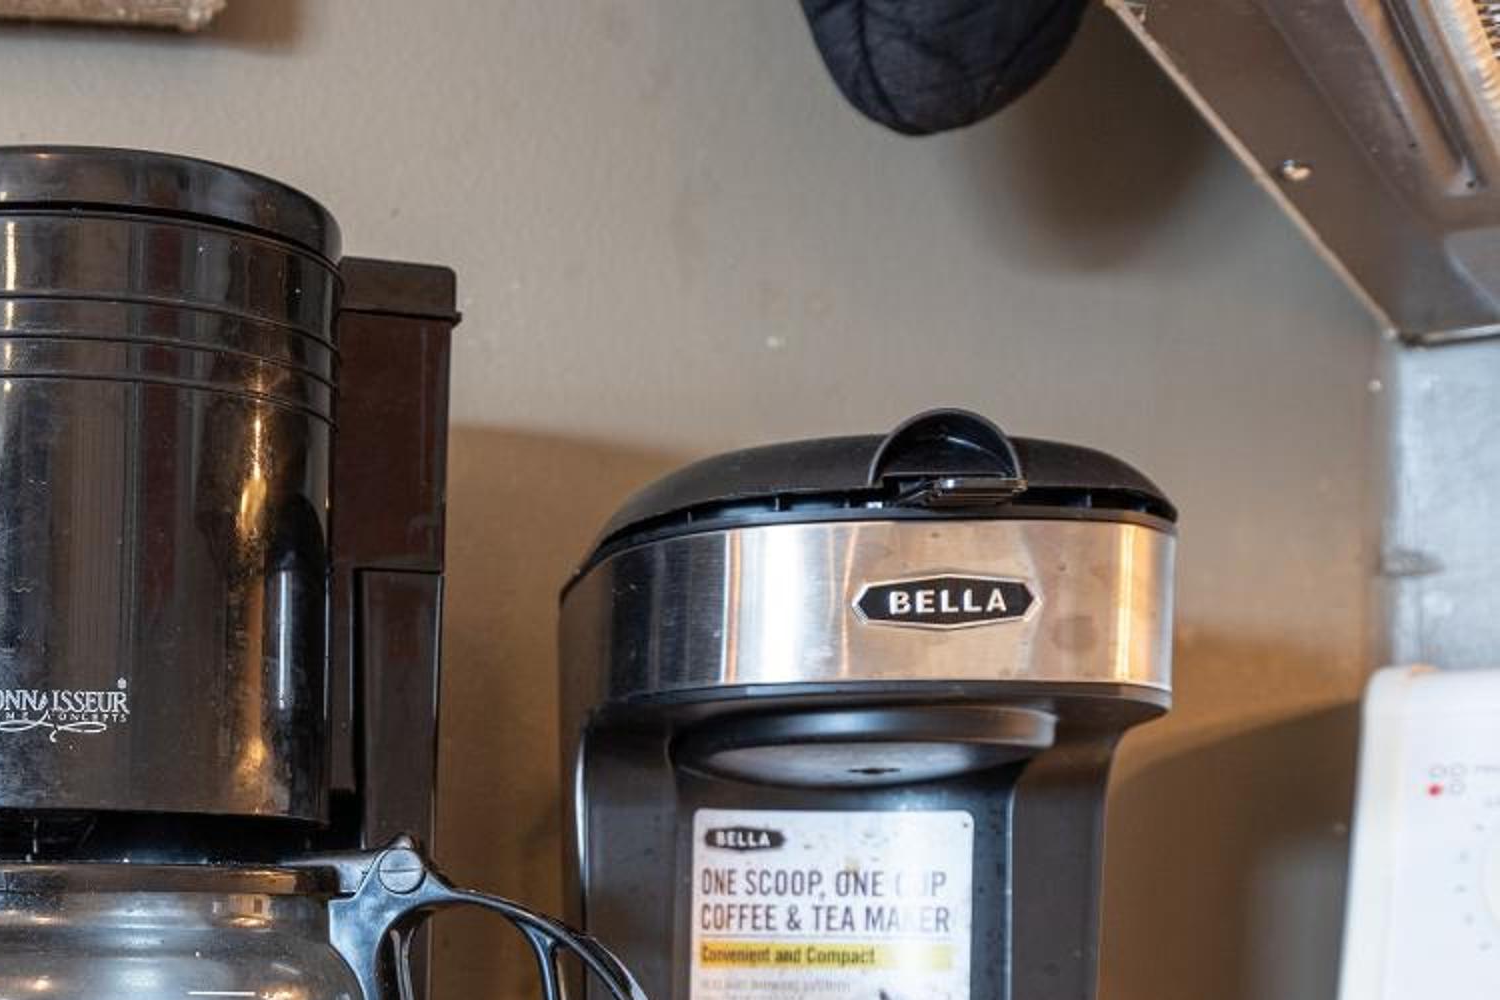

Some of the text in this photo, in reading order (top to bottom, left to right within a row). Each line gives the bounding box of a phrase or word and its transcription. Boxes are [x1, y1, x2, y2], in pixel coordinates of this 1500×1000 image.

[889, 587, 1008, 615] BELLA
[715, 830, 771, 848] BELLA
[701, 868, 738, 896] ONE
[745, 869, 826, 900] SCOOP,
[835, 870, 884, 897] ONE
[701, 903, 949, 933] COFFEE & TEA MAER
[774, 947, 801, 964] and
[807, 947, 876, 967] Compact
